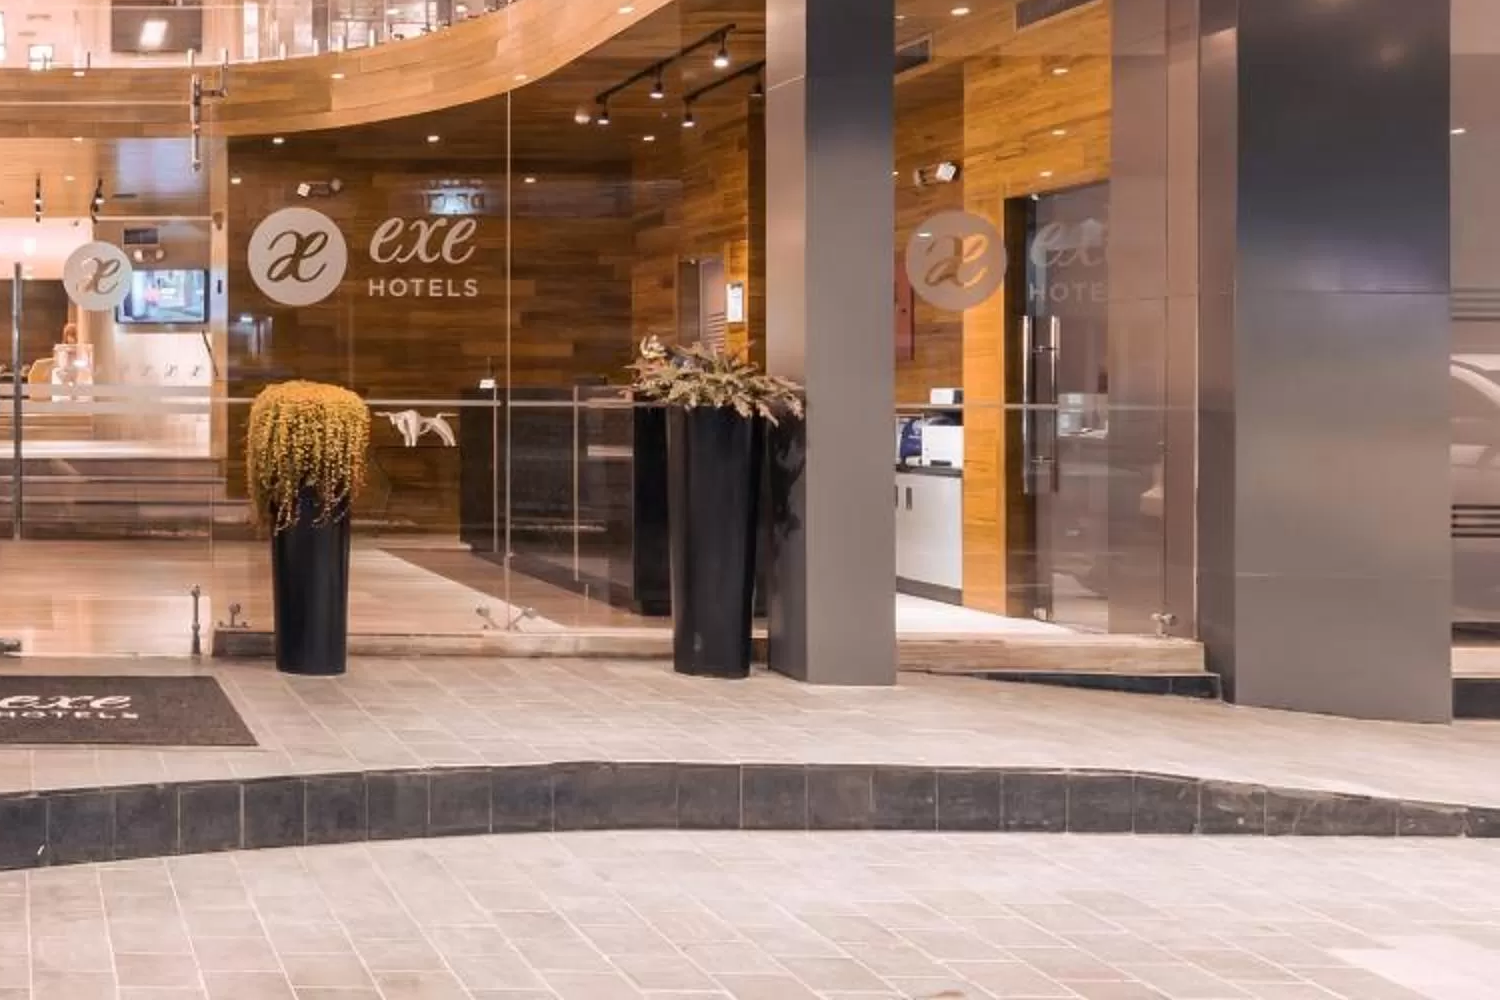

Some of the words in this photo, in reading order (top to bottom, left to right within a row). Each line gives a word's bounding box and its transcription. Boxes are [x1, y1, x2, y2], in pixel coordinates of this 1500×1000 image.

[368, 216, 478, 264] exe
[1030, 219, 1108, 267] ex
[368, 279, 478, 297] HOTELS
[1029, 281, 1108, 303] HOTE
